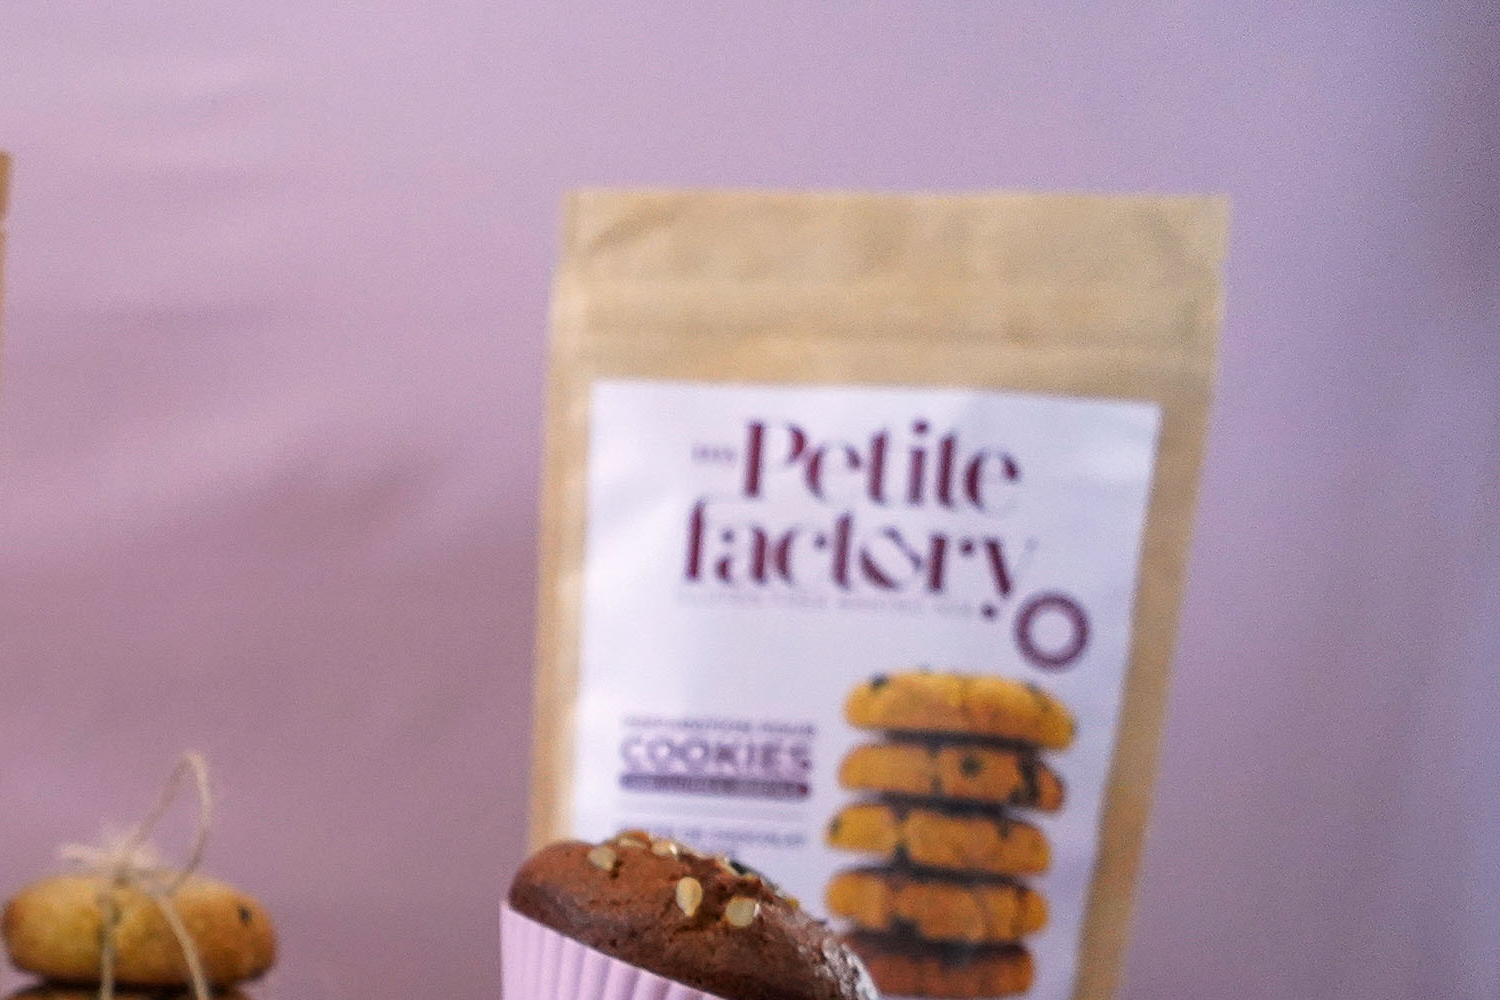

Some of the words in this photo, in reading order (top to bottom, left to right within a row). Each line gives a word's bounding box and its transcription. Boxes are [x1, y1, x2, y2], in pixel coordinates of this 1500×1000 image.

[742, 418, 1024, 509] Petite
[683, 496, 1038, 620] factory
[621, 737, 812, 774] COOKIES
